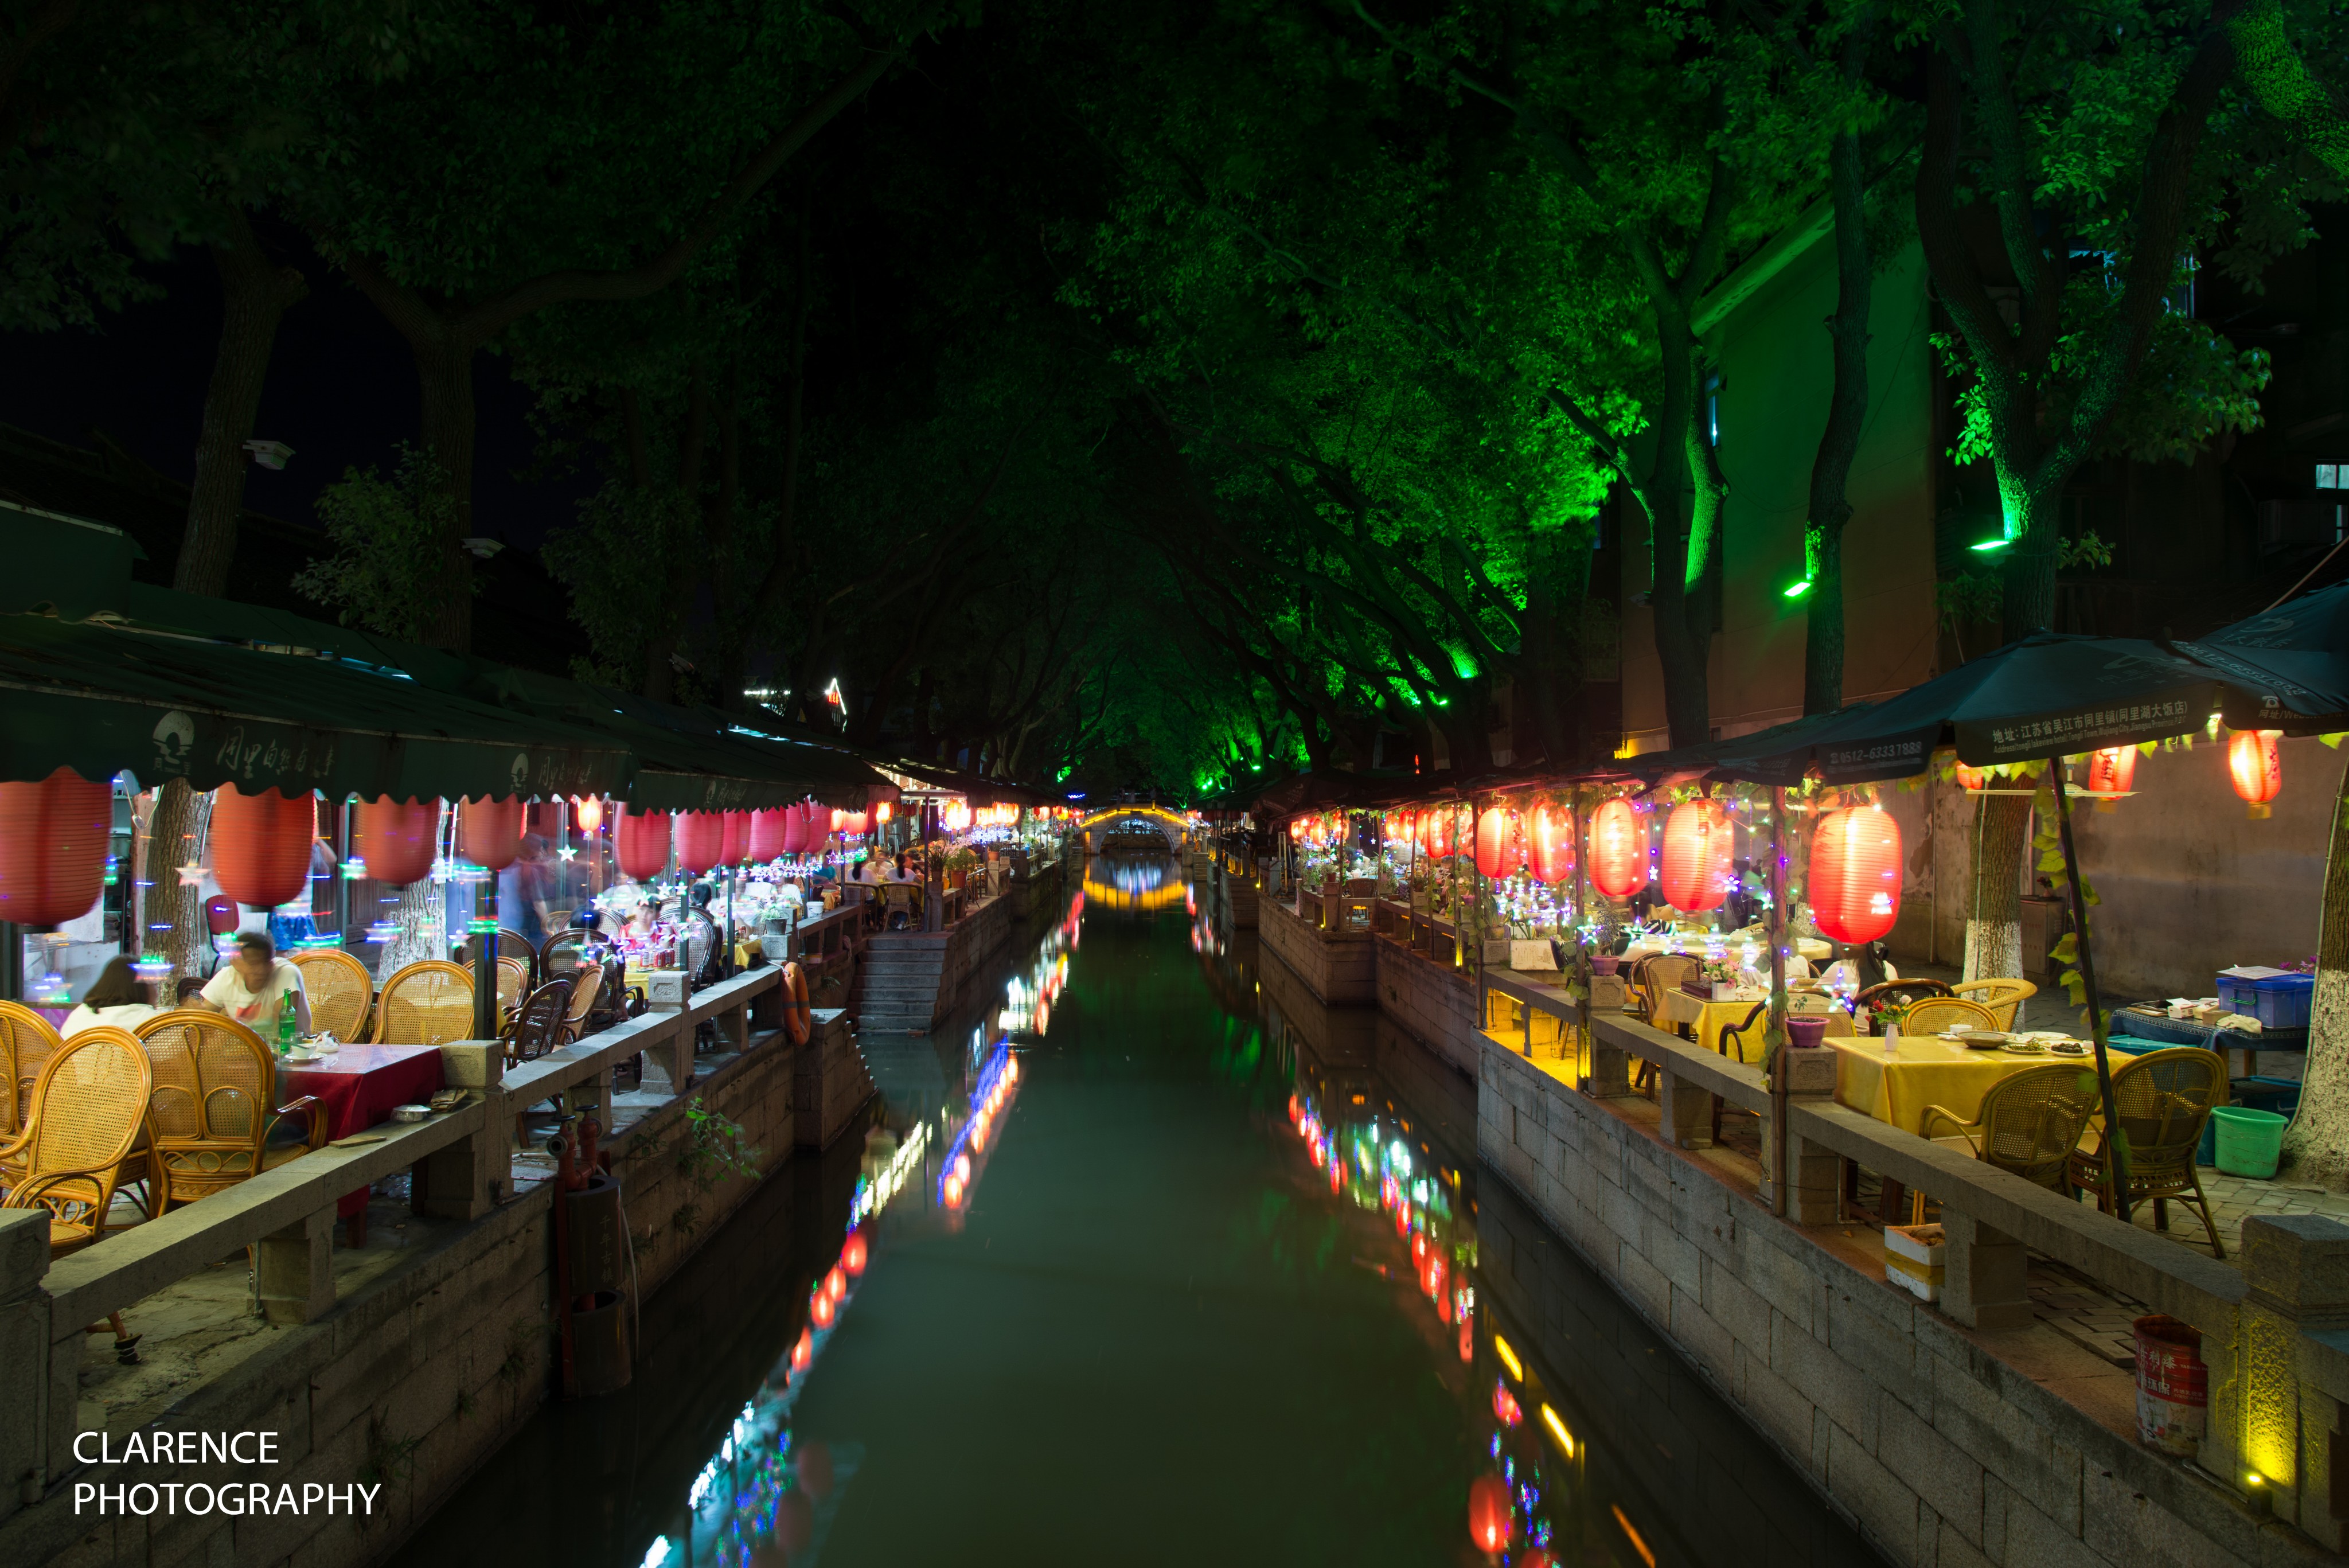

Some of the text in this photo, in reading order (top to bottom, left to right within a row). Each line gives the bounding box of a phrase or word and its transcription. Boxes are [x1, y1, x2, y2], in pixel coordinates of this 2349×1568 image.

[1840, 741, 1922, 763] 0512-63337888
[599, 1214, 614, 1284] 千年古镇
